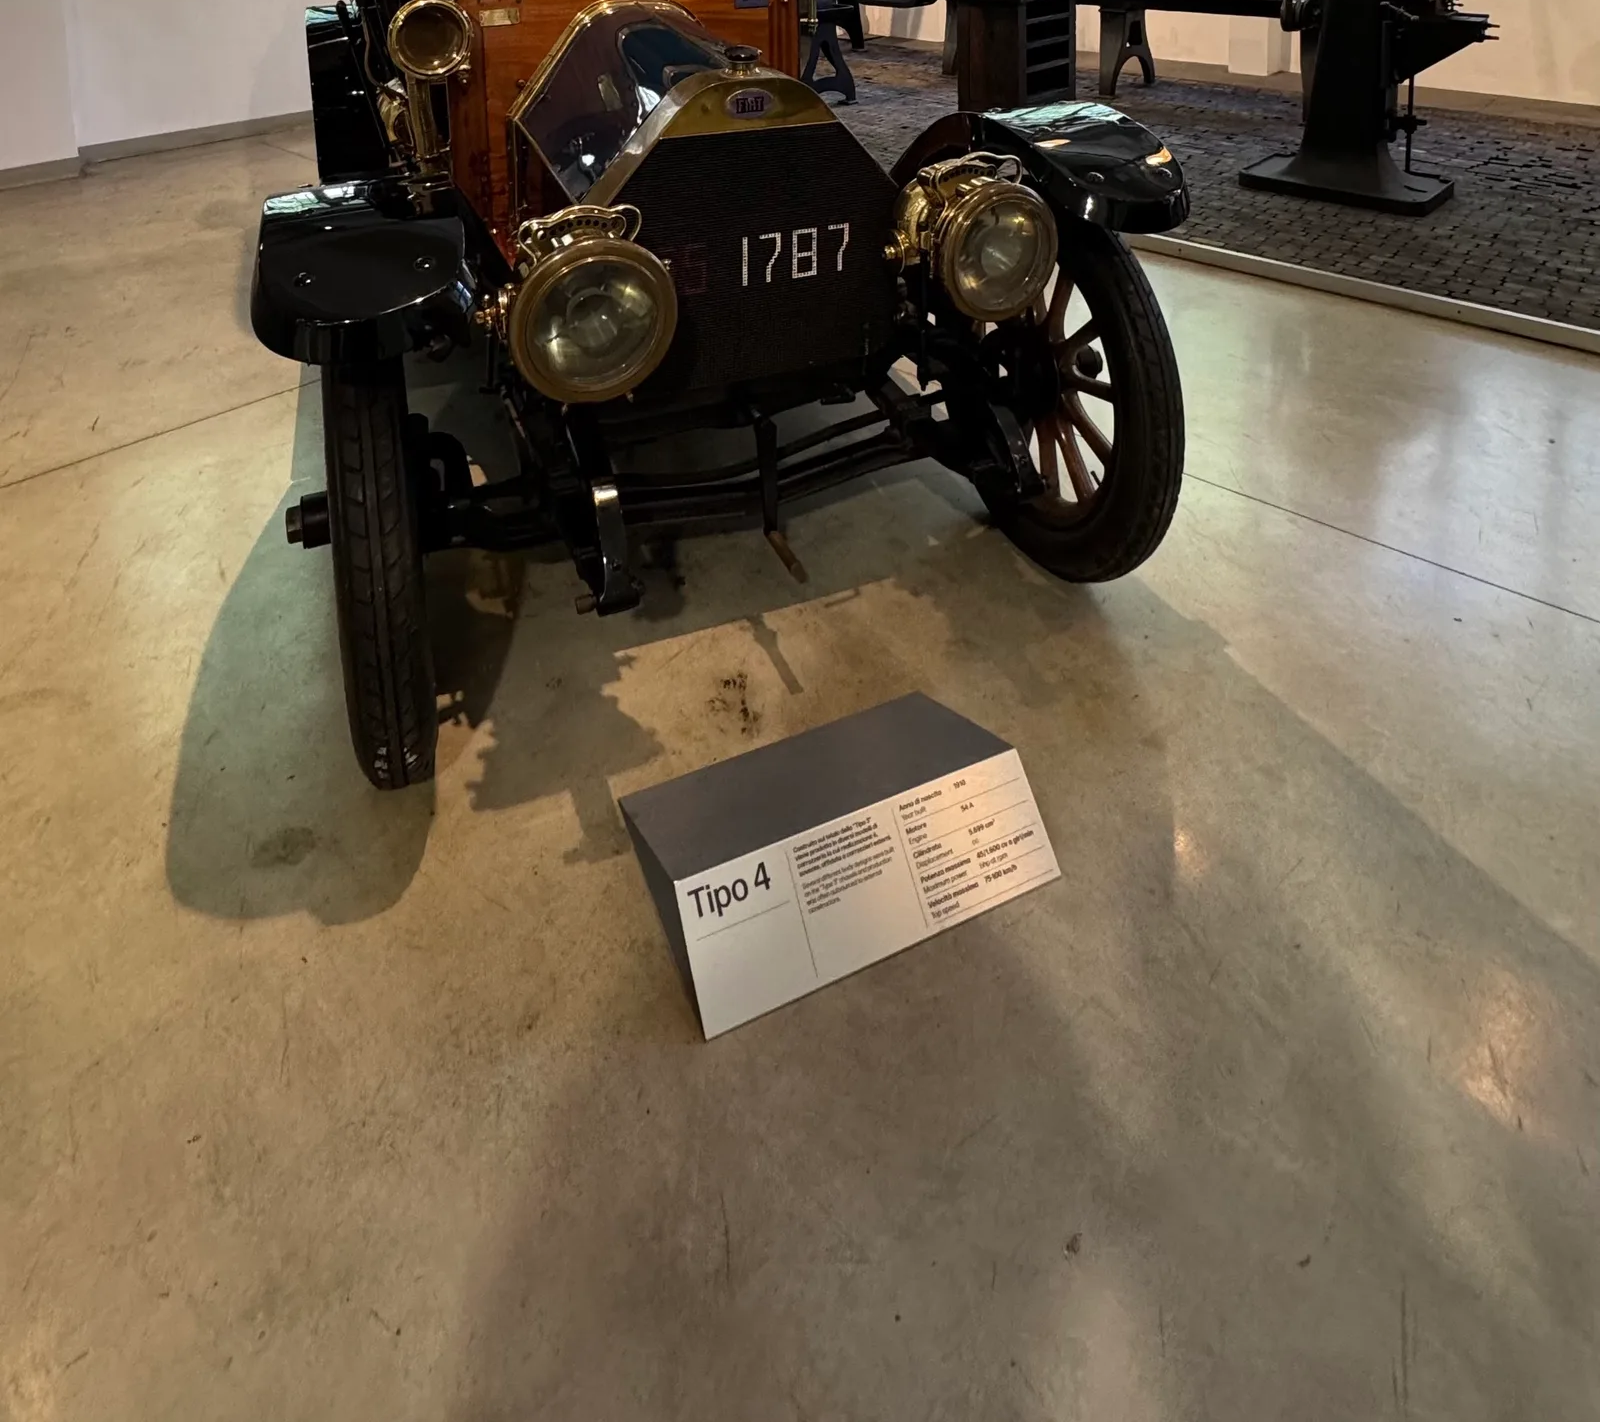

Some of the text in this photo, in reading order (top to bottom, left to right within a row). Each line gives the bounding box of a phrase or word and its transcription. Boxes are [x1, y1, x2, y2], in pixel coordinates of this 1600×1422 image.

[736, 97, 764, 113] FIAT
[741, 221, 850, 286] 1787
[899, 802, 914, 812] Anno
[921, 790, 942, 802] nascita
[953, 779, 966, 789] 1910
[901, 806, 926, 820] Year built
[905, 823, 927, 835] Motore
[960, 804, 969, 812] 54
[908, 834, 927, 845] Engine
[913, 843, 942, 859] Cilindrata
[916, 848, 954, 869] Displacement
[920, 869, 945, 884] Potenza
[945, 858, 971, 873] massima
[923, 878, 950, 894] Maximum
[951, 870, 967, 883] power
[953, 882, 979, 898] massima
[1002, 864, 1017, 875] km/h
[687, 862, 771, 918] Tipo 4
[931, 901, 960, 919] Top speed
